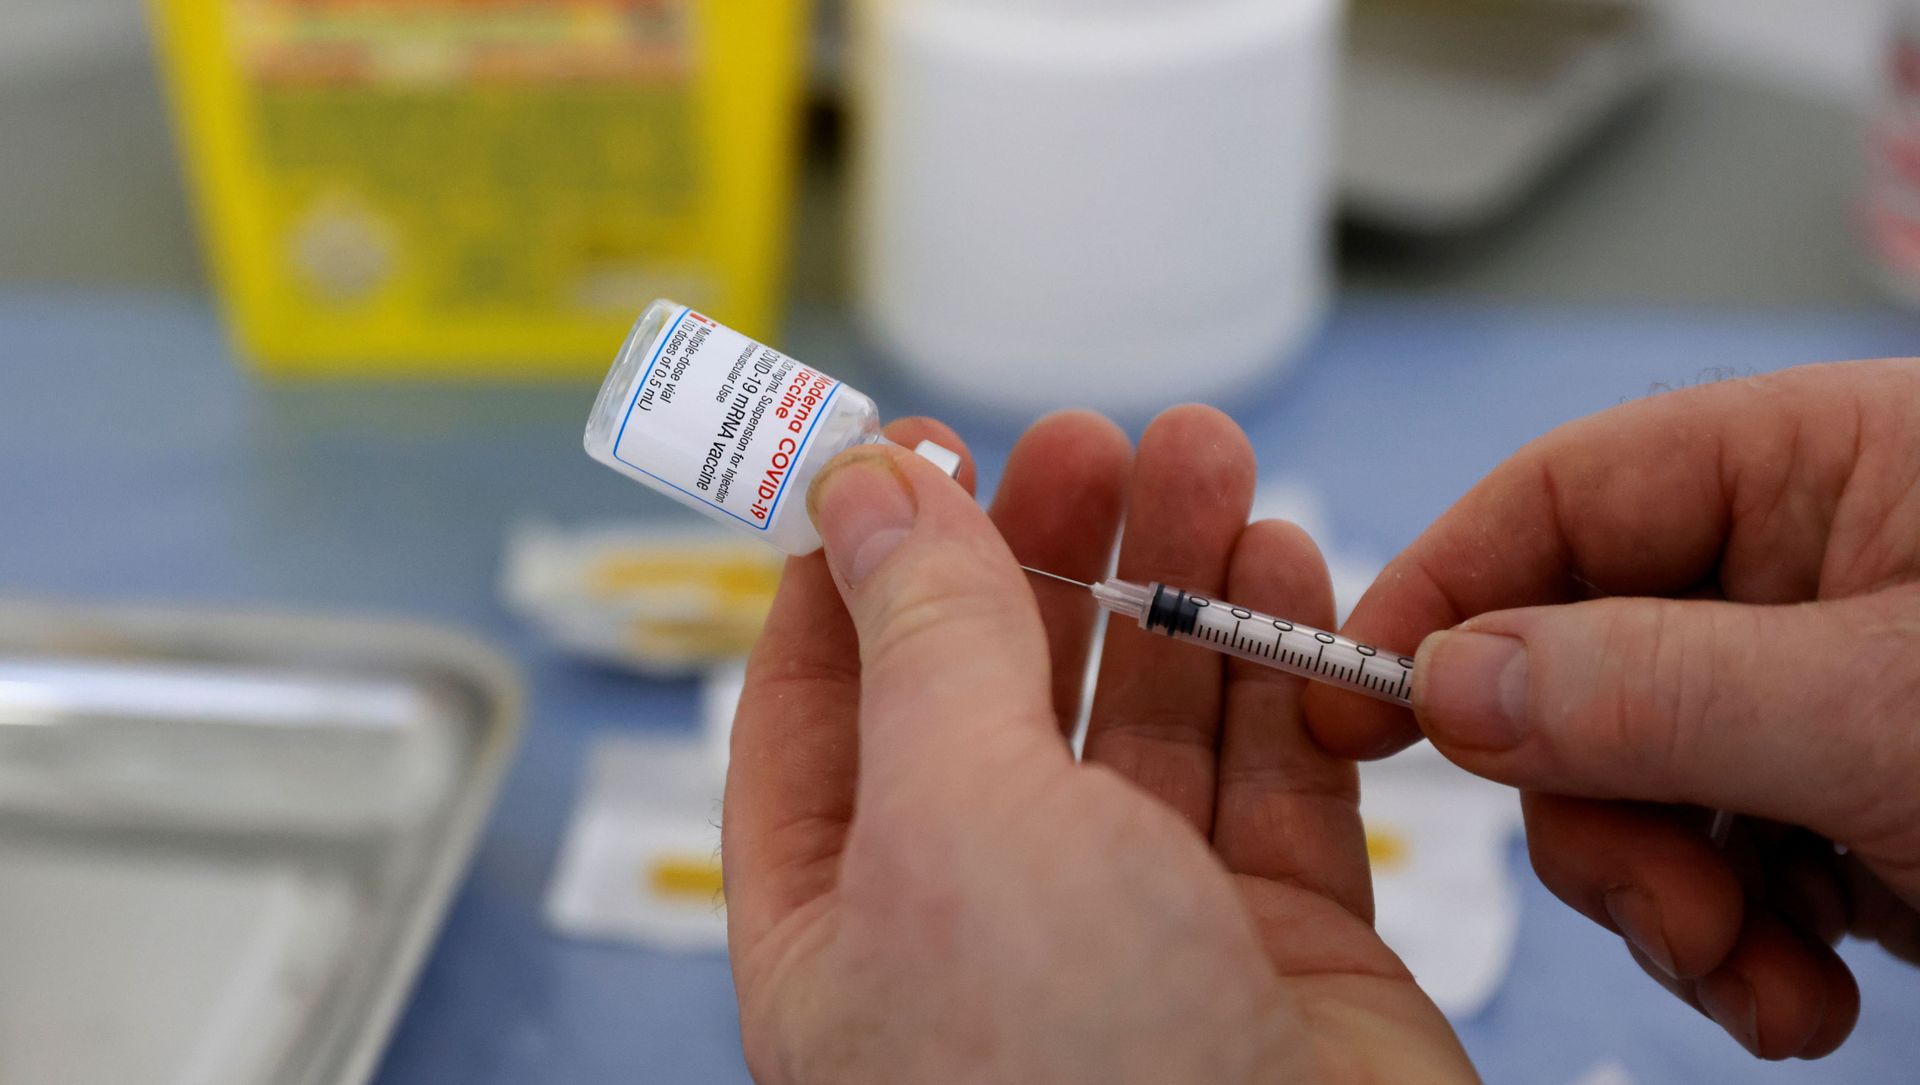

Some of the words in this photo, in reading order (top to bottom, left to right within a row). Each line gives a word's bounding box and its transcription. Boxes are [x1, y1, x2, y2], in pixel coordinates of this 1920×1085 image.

[665, 330, 688, 355] doses
[670, 327, 711, 381] Multiple-dose
[649, 368, 666, 388] 0.5
[659, 356, 671, 369] of
[741, 348, 781, 394] COVID-19
[764, 368, 786, 393] mg/mL
[637, 387, 654, 411] mL)
[659, 383, 676, 403] vial
[715, 383, 734, 403] Use
[775, 368, 816, 419] Vaccine
[787, 374, 834, 433] Moderna
[716, 392, 749, 439] mRNA
[735, 394, 772, 451] Suspension
[696, 441, 726, 490] vaccine
[729, 451, 744, 468] for
[715, 467, 737, 503] Injection
[750, 437, 796, 519] COVID-19
